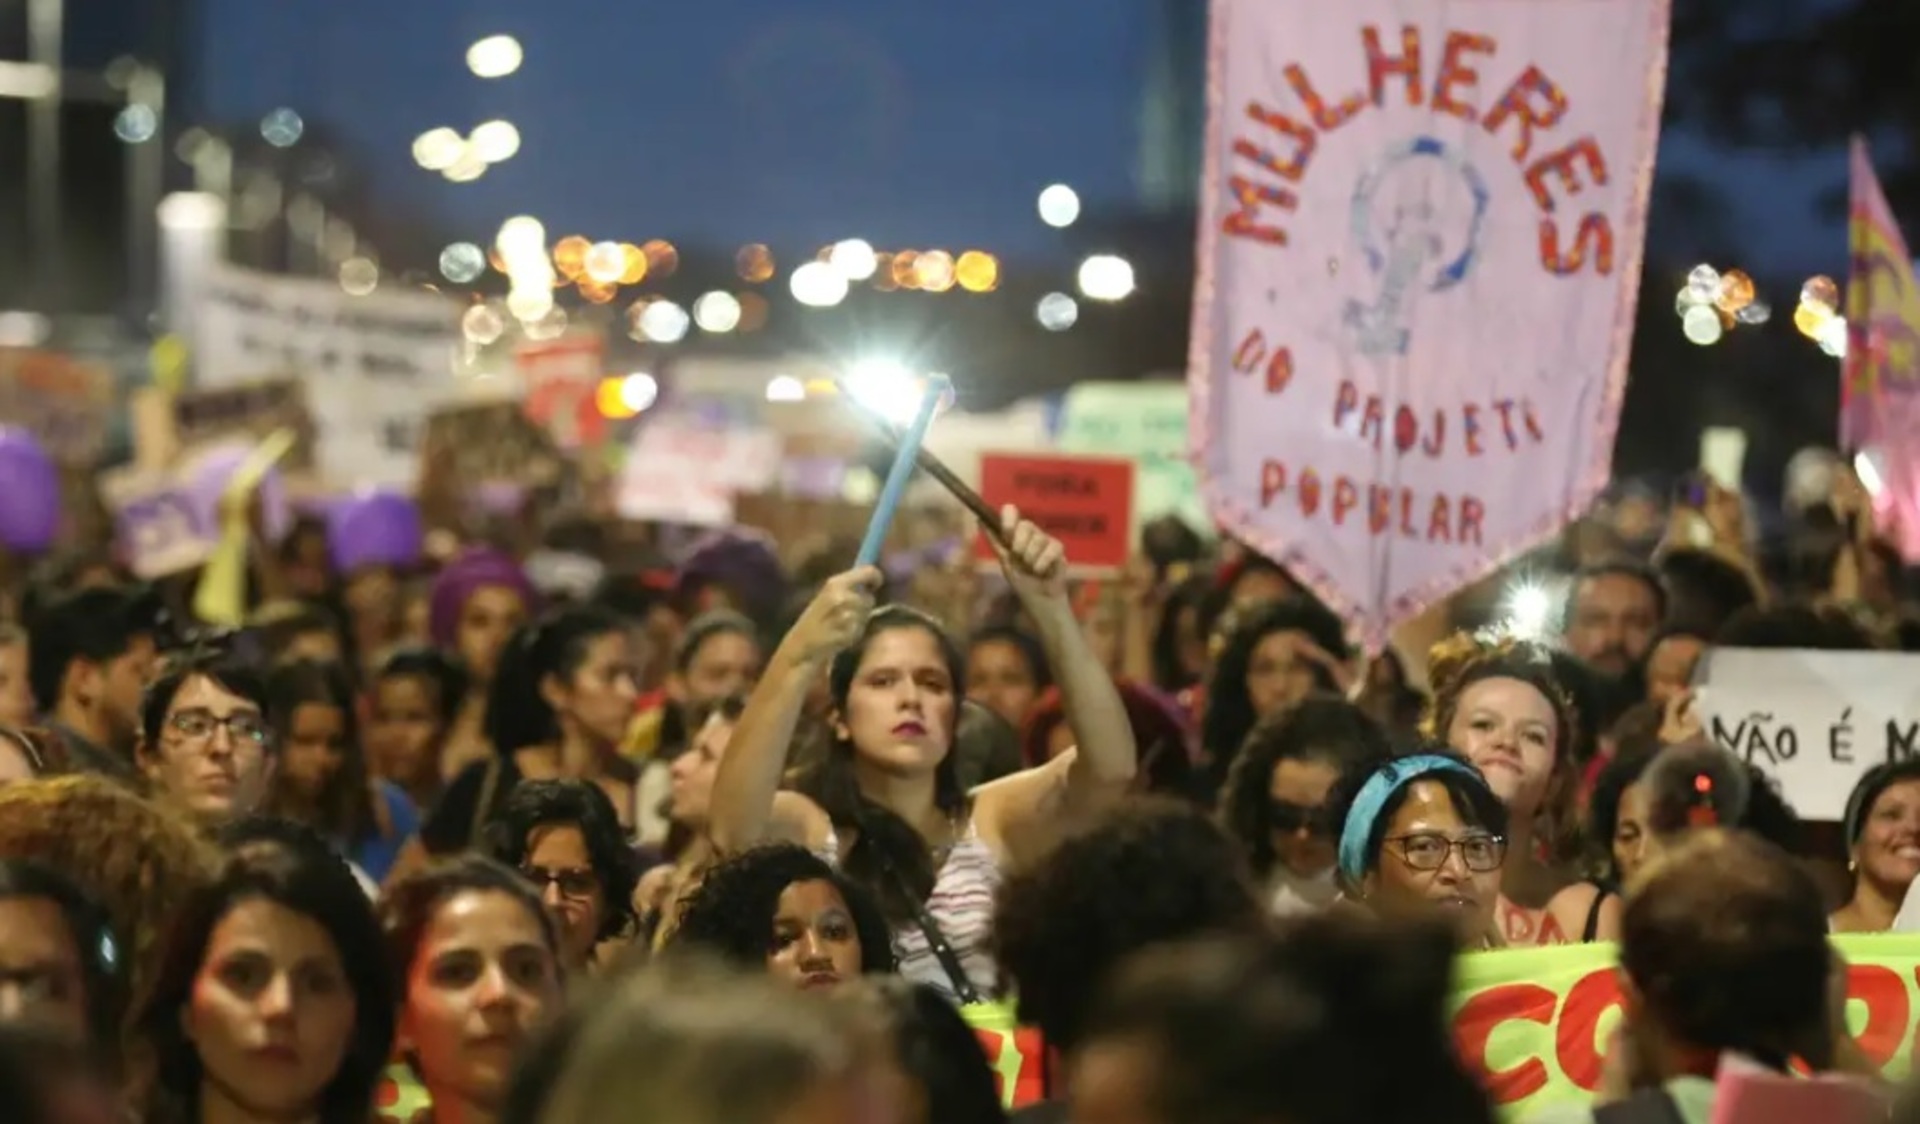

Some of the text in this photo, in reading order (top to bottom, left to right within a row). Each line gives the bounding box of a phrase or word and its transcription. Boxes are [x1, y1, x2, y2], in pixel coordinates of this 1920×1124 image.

[1222, 25, 1614, 277] MULHERES
[1231, 327, 1294, 394] DO
[1260, 458, 1485, 547] POPULAR
[1712, 711, 1798, 766] NÃO
[1828, 705, 1856, 764] É
